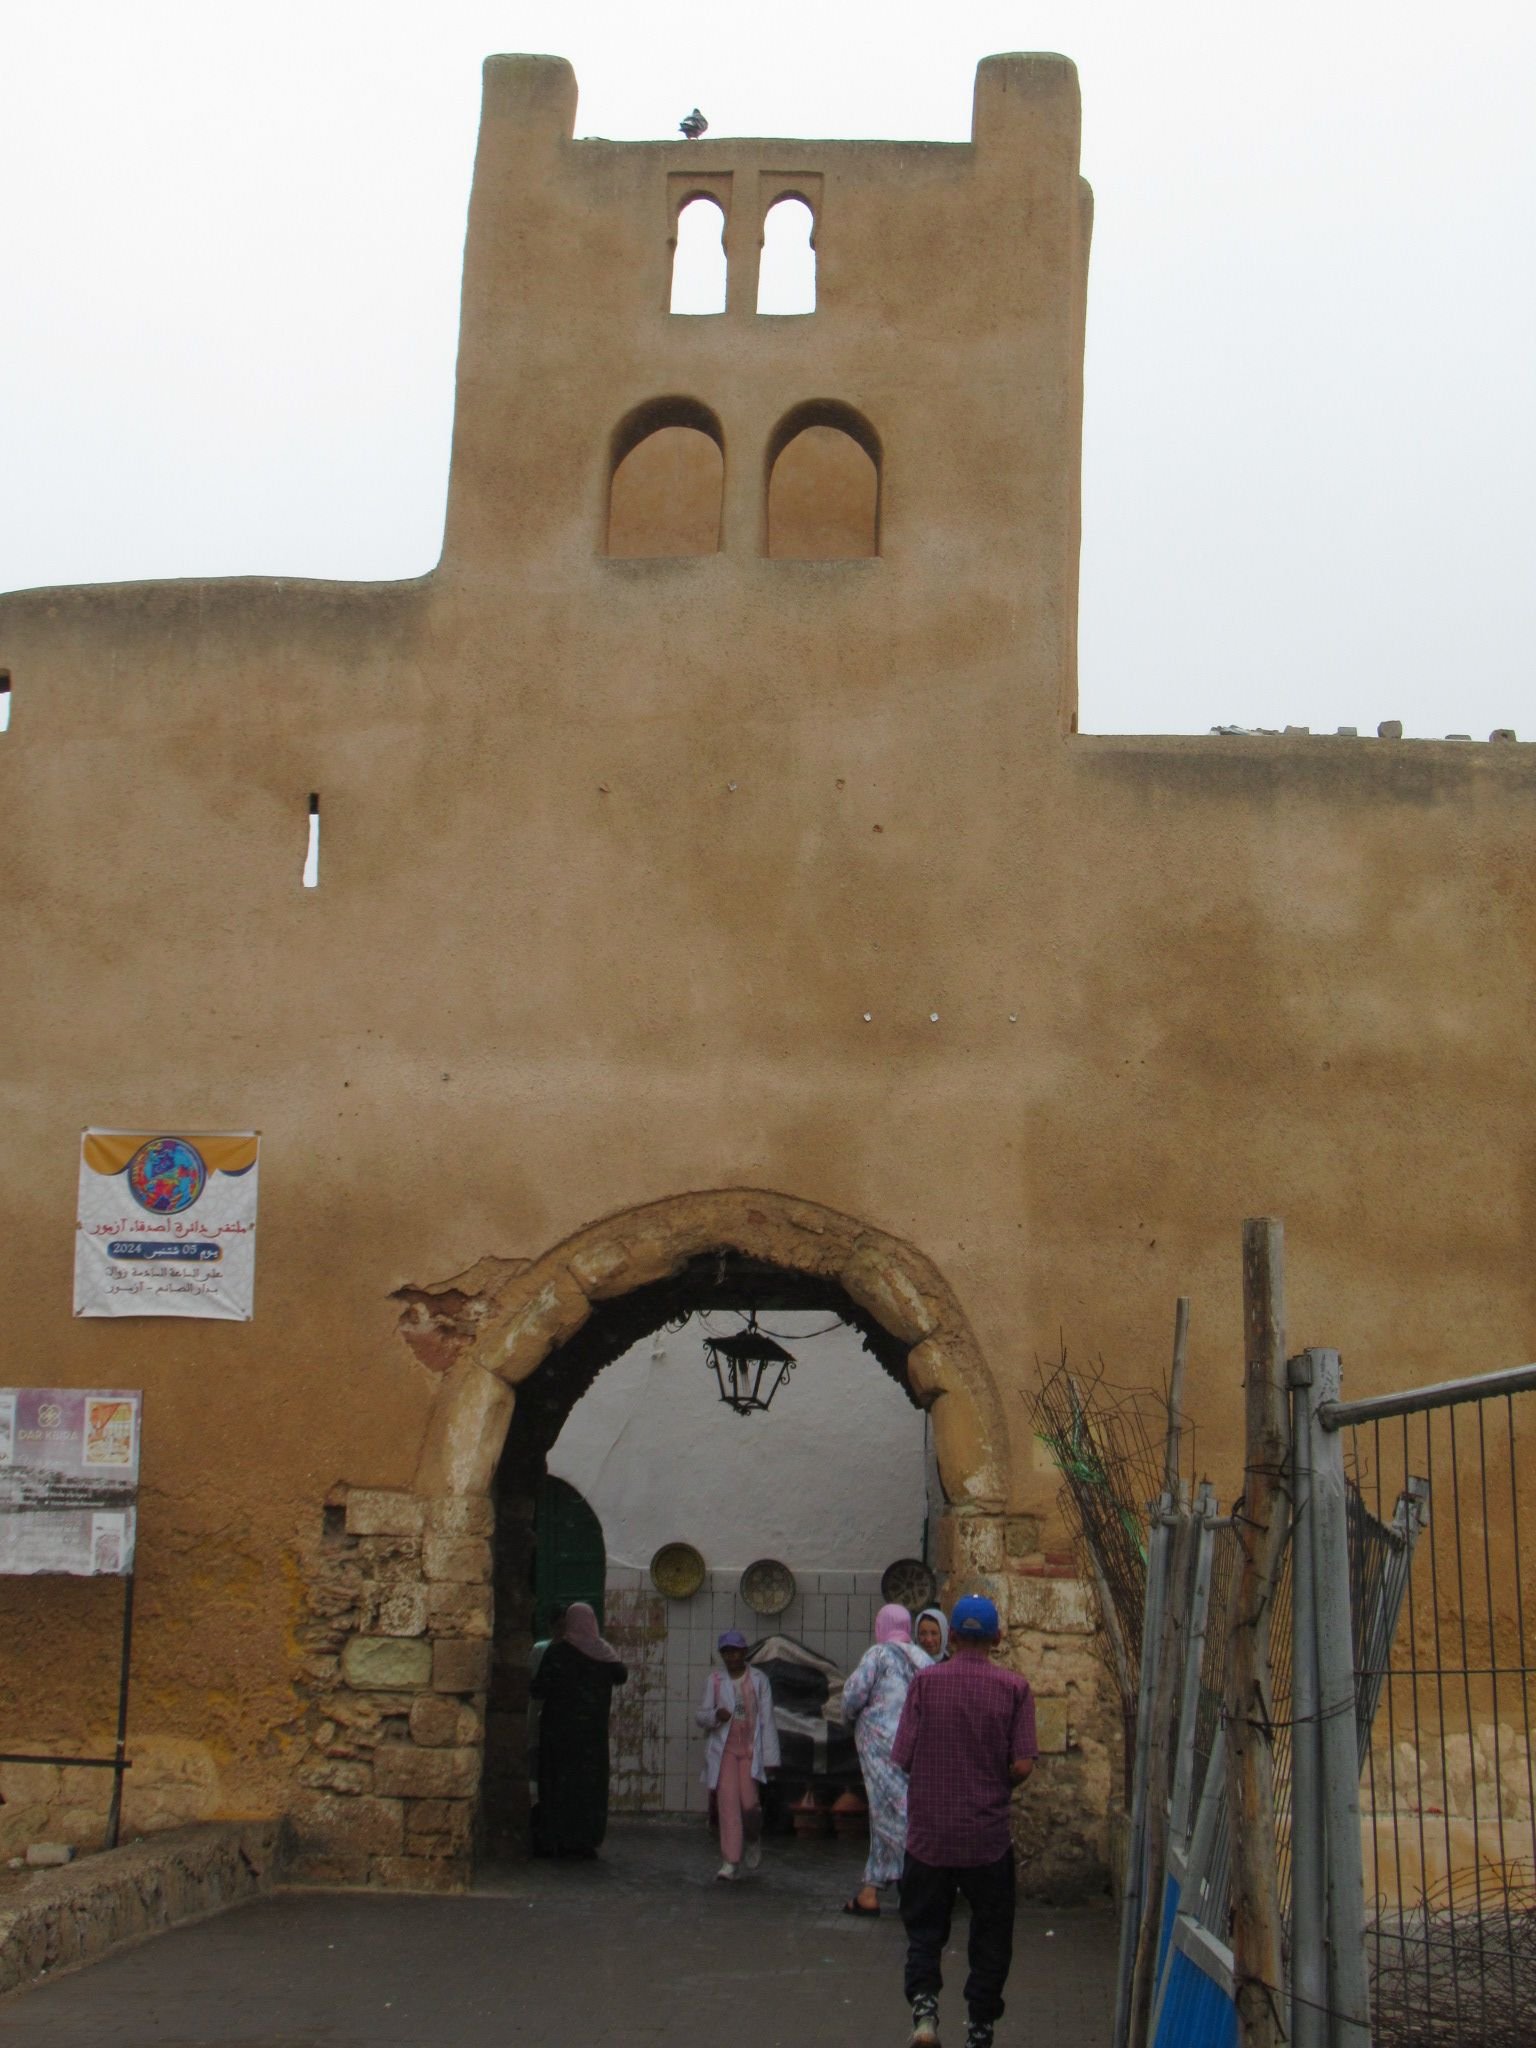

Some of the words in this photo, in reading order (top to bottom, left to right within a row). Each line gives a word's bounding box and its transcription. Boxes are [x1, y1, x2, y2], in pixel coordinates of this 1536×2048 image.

[89, 1218, 127, 1235] آزمور
[129, 1219, 170, 1232] أصدقاء
[112, 1243, 143, 1254] 2024
[145, 1246, 180, 1259] شتنبر
[182, 1244, 198, 1254] 05
[199, 1247, 219, 1260] يوم
[18, 1429, 43, 1441] DAR
